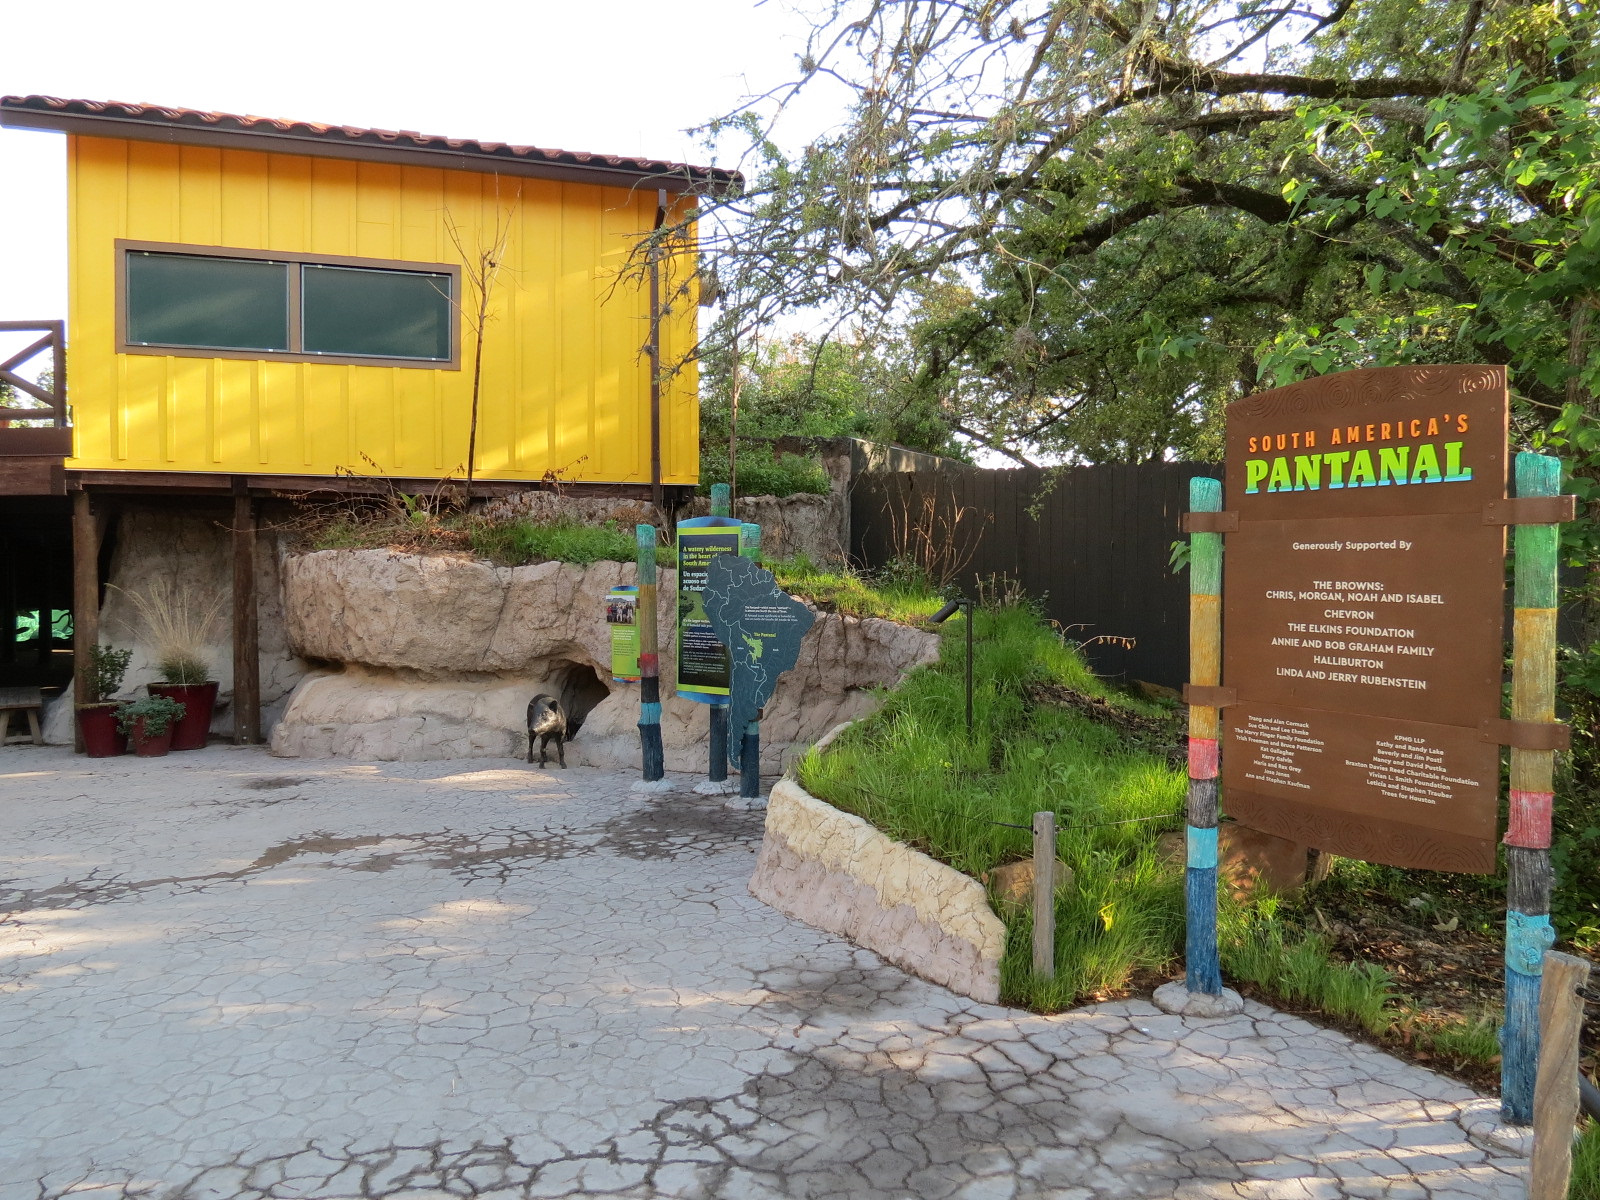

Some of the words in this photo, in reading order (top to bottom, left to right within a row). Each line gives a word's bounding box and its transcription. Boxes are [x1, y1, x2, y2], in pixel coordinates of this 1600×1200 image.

[1249, 431, 1315, 453] SOUTH
[1331, 414, 1469, 445] AMERICA'S
[1245, 442, 1473, 494] PANTANAL
[1293, 541, 1343, 551] Generously
[1346, 540, 1396, 551] Supported
[1399, 541, 1412, 551] By
[1313, 581, 1332, 590] THE
[1335, 582, 1384, 591] BROWNS:
[1266, 591, 1296, 601] CHRIS,
[1299, 592, 1344, 602] MORGAN,
[1348, 593, 1378, 602] NOAH
[1381, 594, 1403, 603] AND
[1406, 595, 1444, 604] ISABEL
[1324, 610, 1374, 620] CHEVRON
[1288, 623, 1306, 632] THE
[1309, 625, 1342, 634] ELKINS
[1346, 626, 1414, 638] FOUNDATION
[1272, 638, 1300, 647] ANNIE
[1302, 639, 1322, 648] AND
[1325, 641, 1345, 650] BOB
[1349, 642, 1394, 653] GRAHAM
[1397, 646, 1435, 657] FAMILY
[1314, 656, 1384, 669] HALLIBURTON
[1277, 668, 1303, 678] LINDA
[1306, 670, 1326, 680] AND
[1328, 673, 1358, 683] JERRY
[1361, 675, 1427, 690] RUBENSTEIN
[1294, 737, 1325, 746] Foundation
[1376, 741, 1394, 749] Kathy
[1408, 745, 1428, 754] Randy
[1297, 745, 1322, 753] Patterson
[1378, 749, 1400, 757] Beverly
[1373, 756, 1391, 765] Nancy
[1406, 761, 1423, 769] David
[1395, 776, 1413, 784] Smith
[1414, 779, 1450, 790] Foundation
[1407, 769, 1440, 780] Charitable
[1441, 775, 1479, 786] Foundation
[1367, 779, 1387, 788] Leticia
[1401, 785, 1426, 795] Stephen
[1381, 790, 1398, 798] Trees
[1409, 795, 1436, 805] Houston
